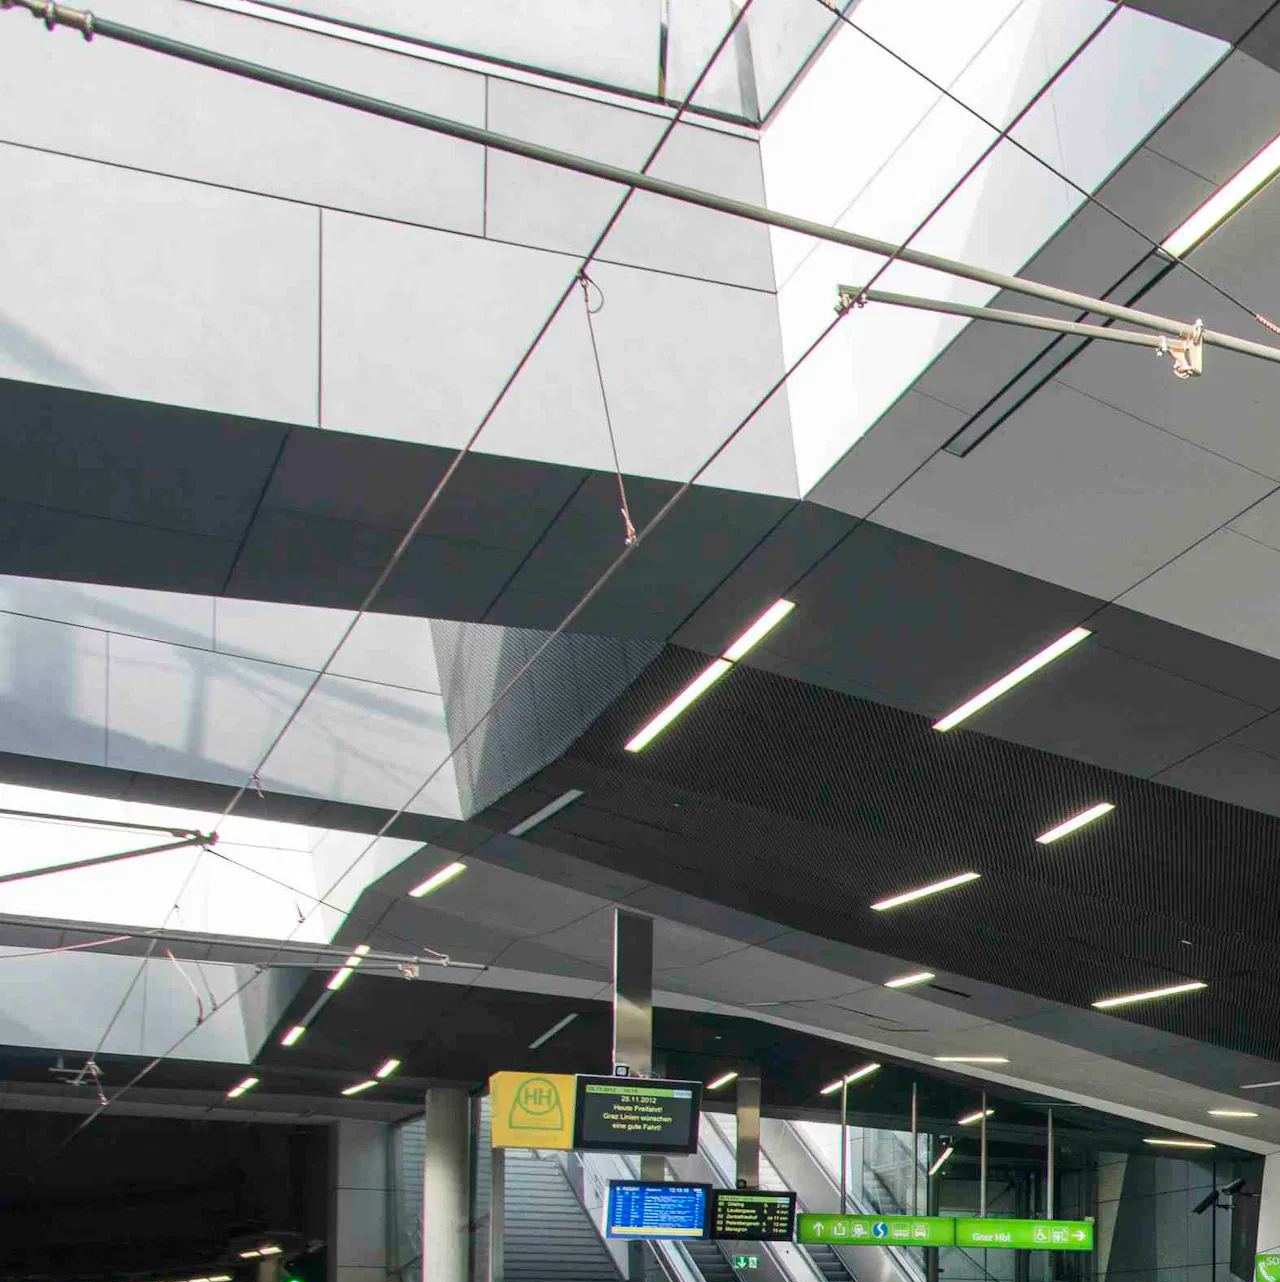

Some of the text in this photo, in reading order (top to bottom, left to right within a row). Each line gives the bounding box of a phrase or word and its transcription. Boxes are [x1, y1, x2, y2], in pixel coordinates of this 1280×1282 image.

[525, 1088, 552, 1106] HH
[613, 1104, 633, 1112] Heute
[602, 1112, 672, 1123] Graz Linien wünschen
[643, 1123, 662, 1131] Fahrt!
[972, 1232, 993, 1242] Graz
